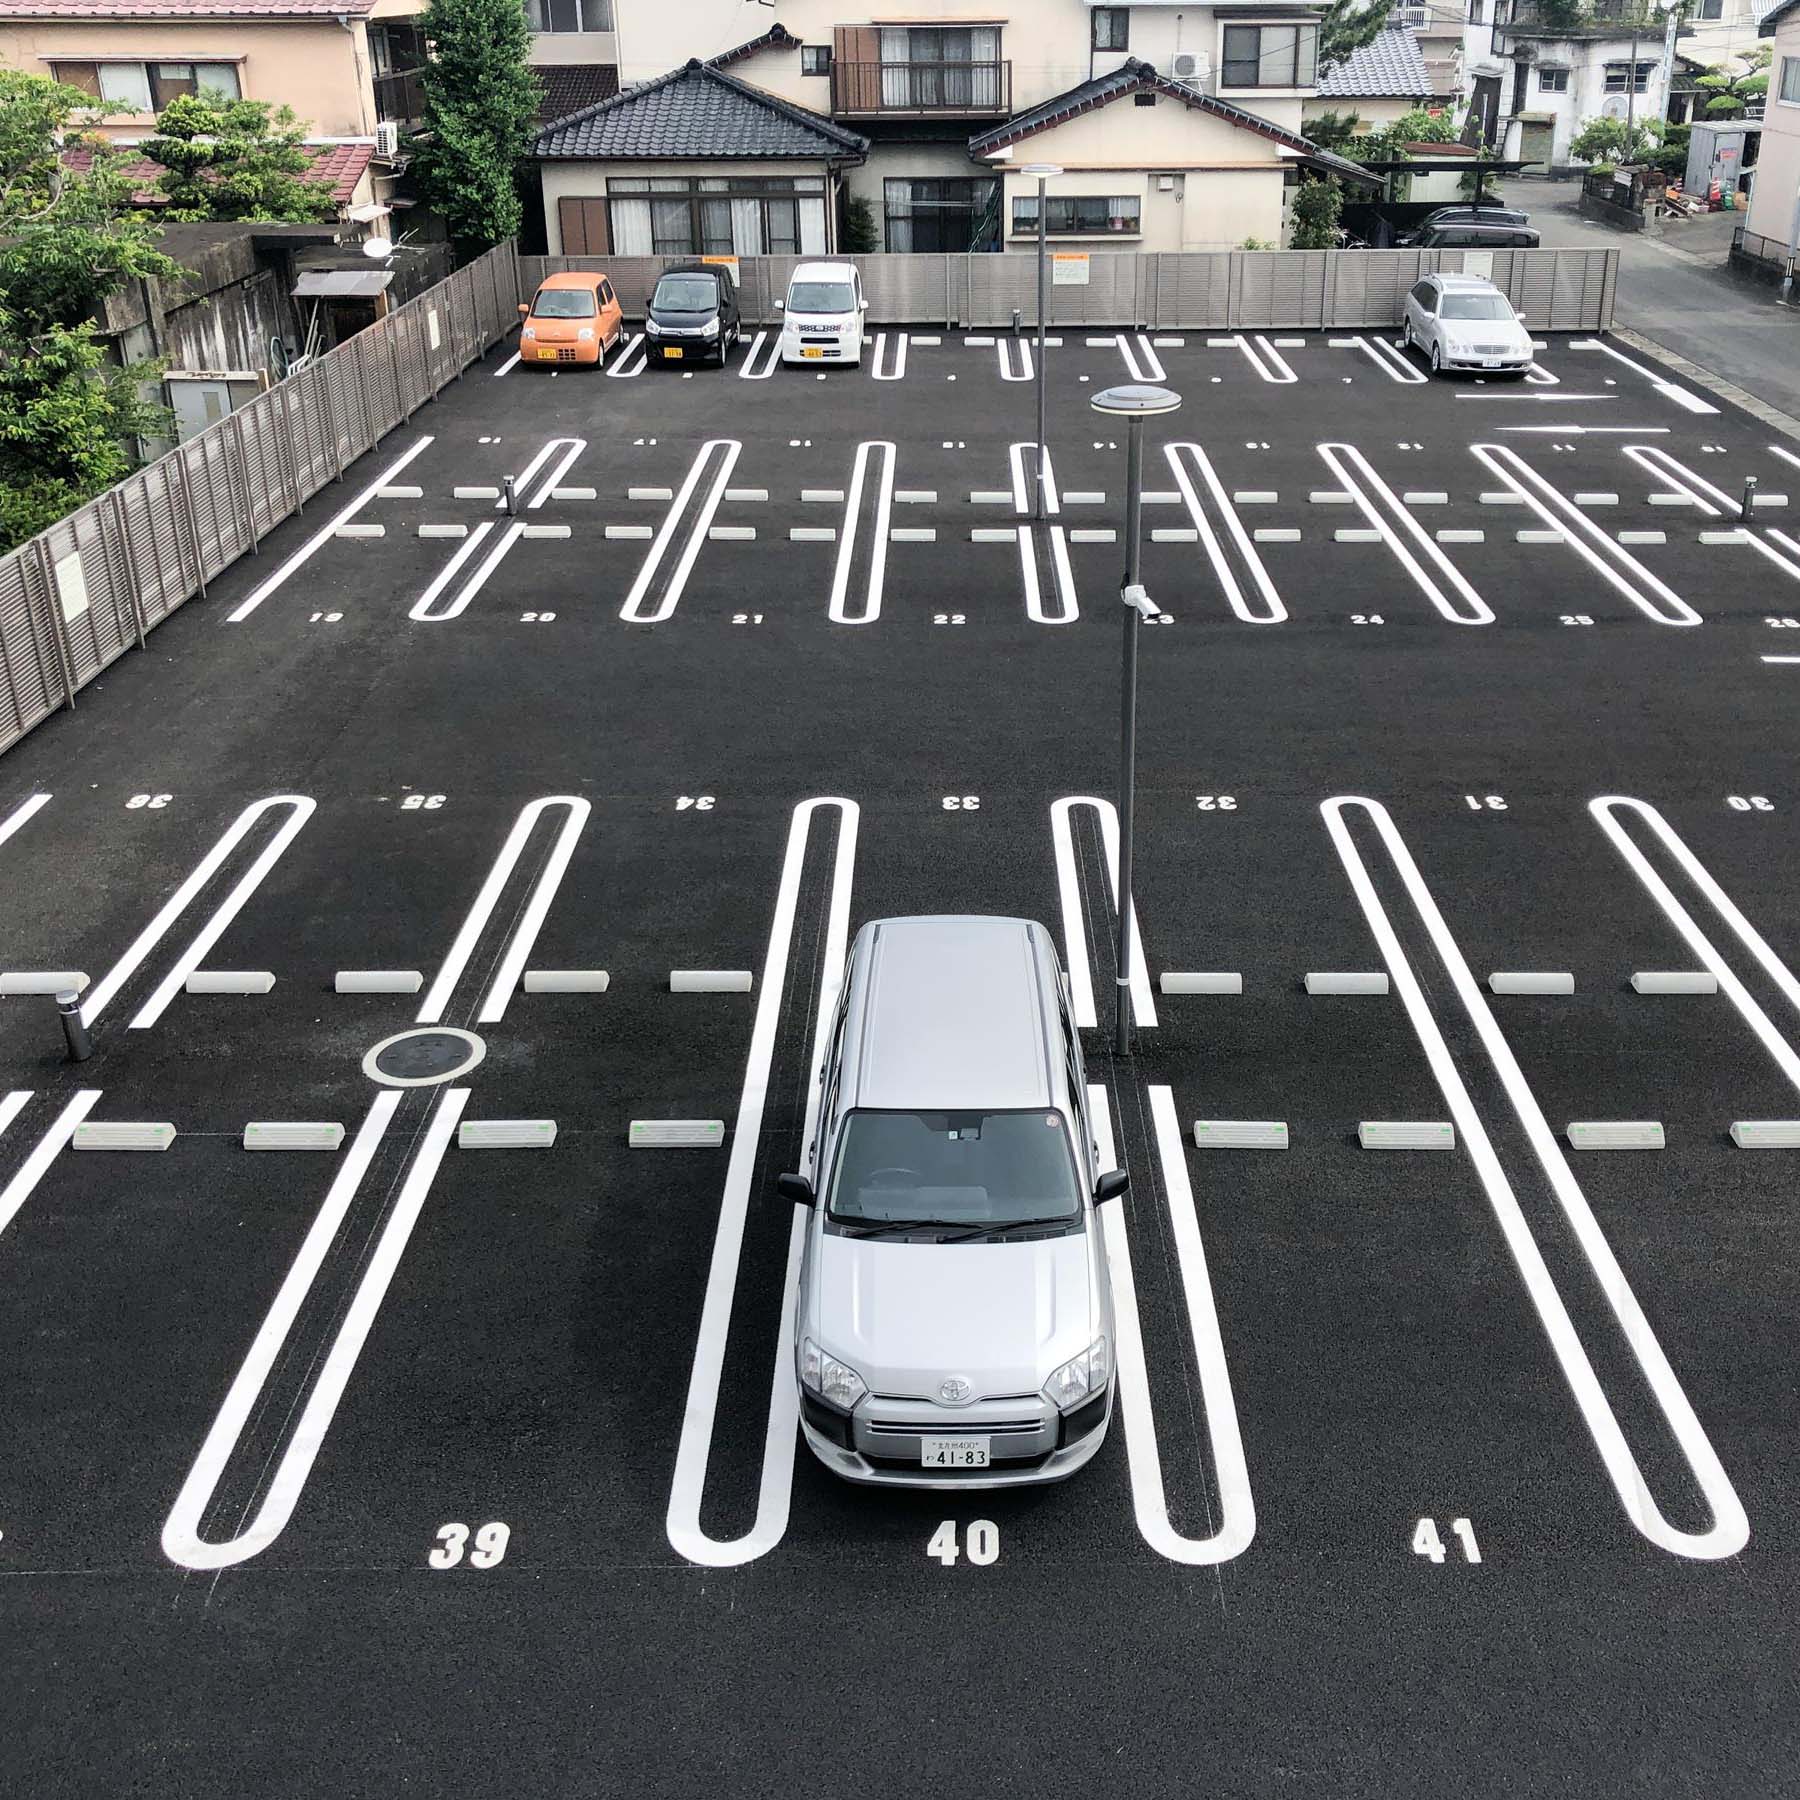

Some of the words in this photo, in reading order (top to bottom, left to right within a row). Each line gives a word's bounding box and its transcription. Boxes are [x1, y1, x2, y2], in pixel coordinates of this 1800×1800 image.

[308, 612, 344, 623] 19
[519, 612, 557, 622] 20
[731, 614, 764, 625] 21
[933, 614, 966, 625] 22
[1350, 614, 1385, 625] 24
[1559, 615, 1595, 626] 25
[124, 793, 174, 810] 36
[400, 794, 447, 810] 35
[675, 796, 716, 811] 34
[942, 795, 980, 811] 33
[1195, 795, 1238, 811] 32
[1464, 795, 1509, 810] 31
[1726, 795, 1775, 811] 30
[937, 1450, 986, 1465] 41-83
[429, 1522, 510, 1569] 39
[927, 1520, 999, 1565] 40
[1412, 1518, 1481, 1563] 41
